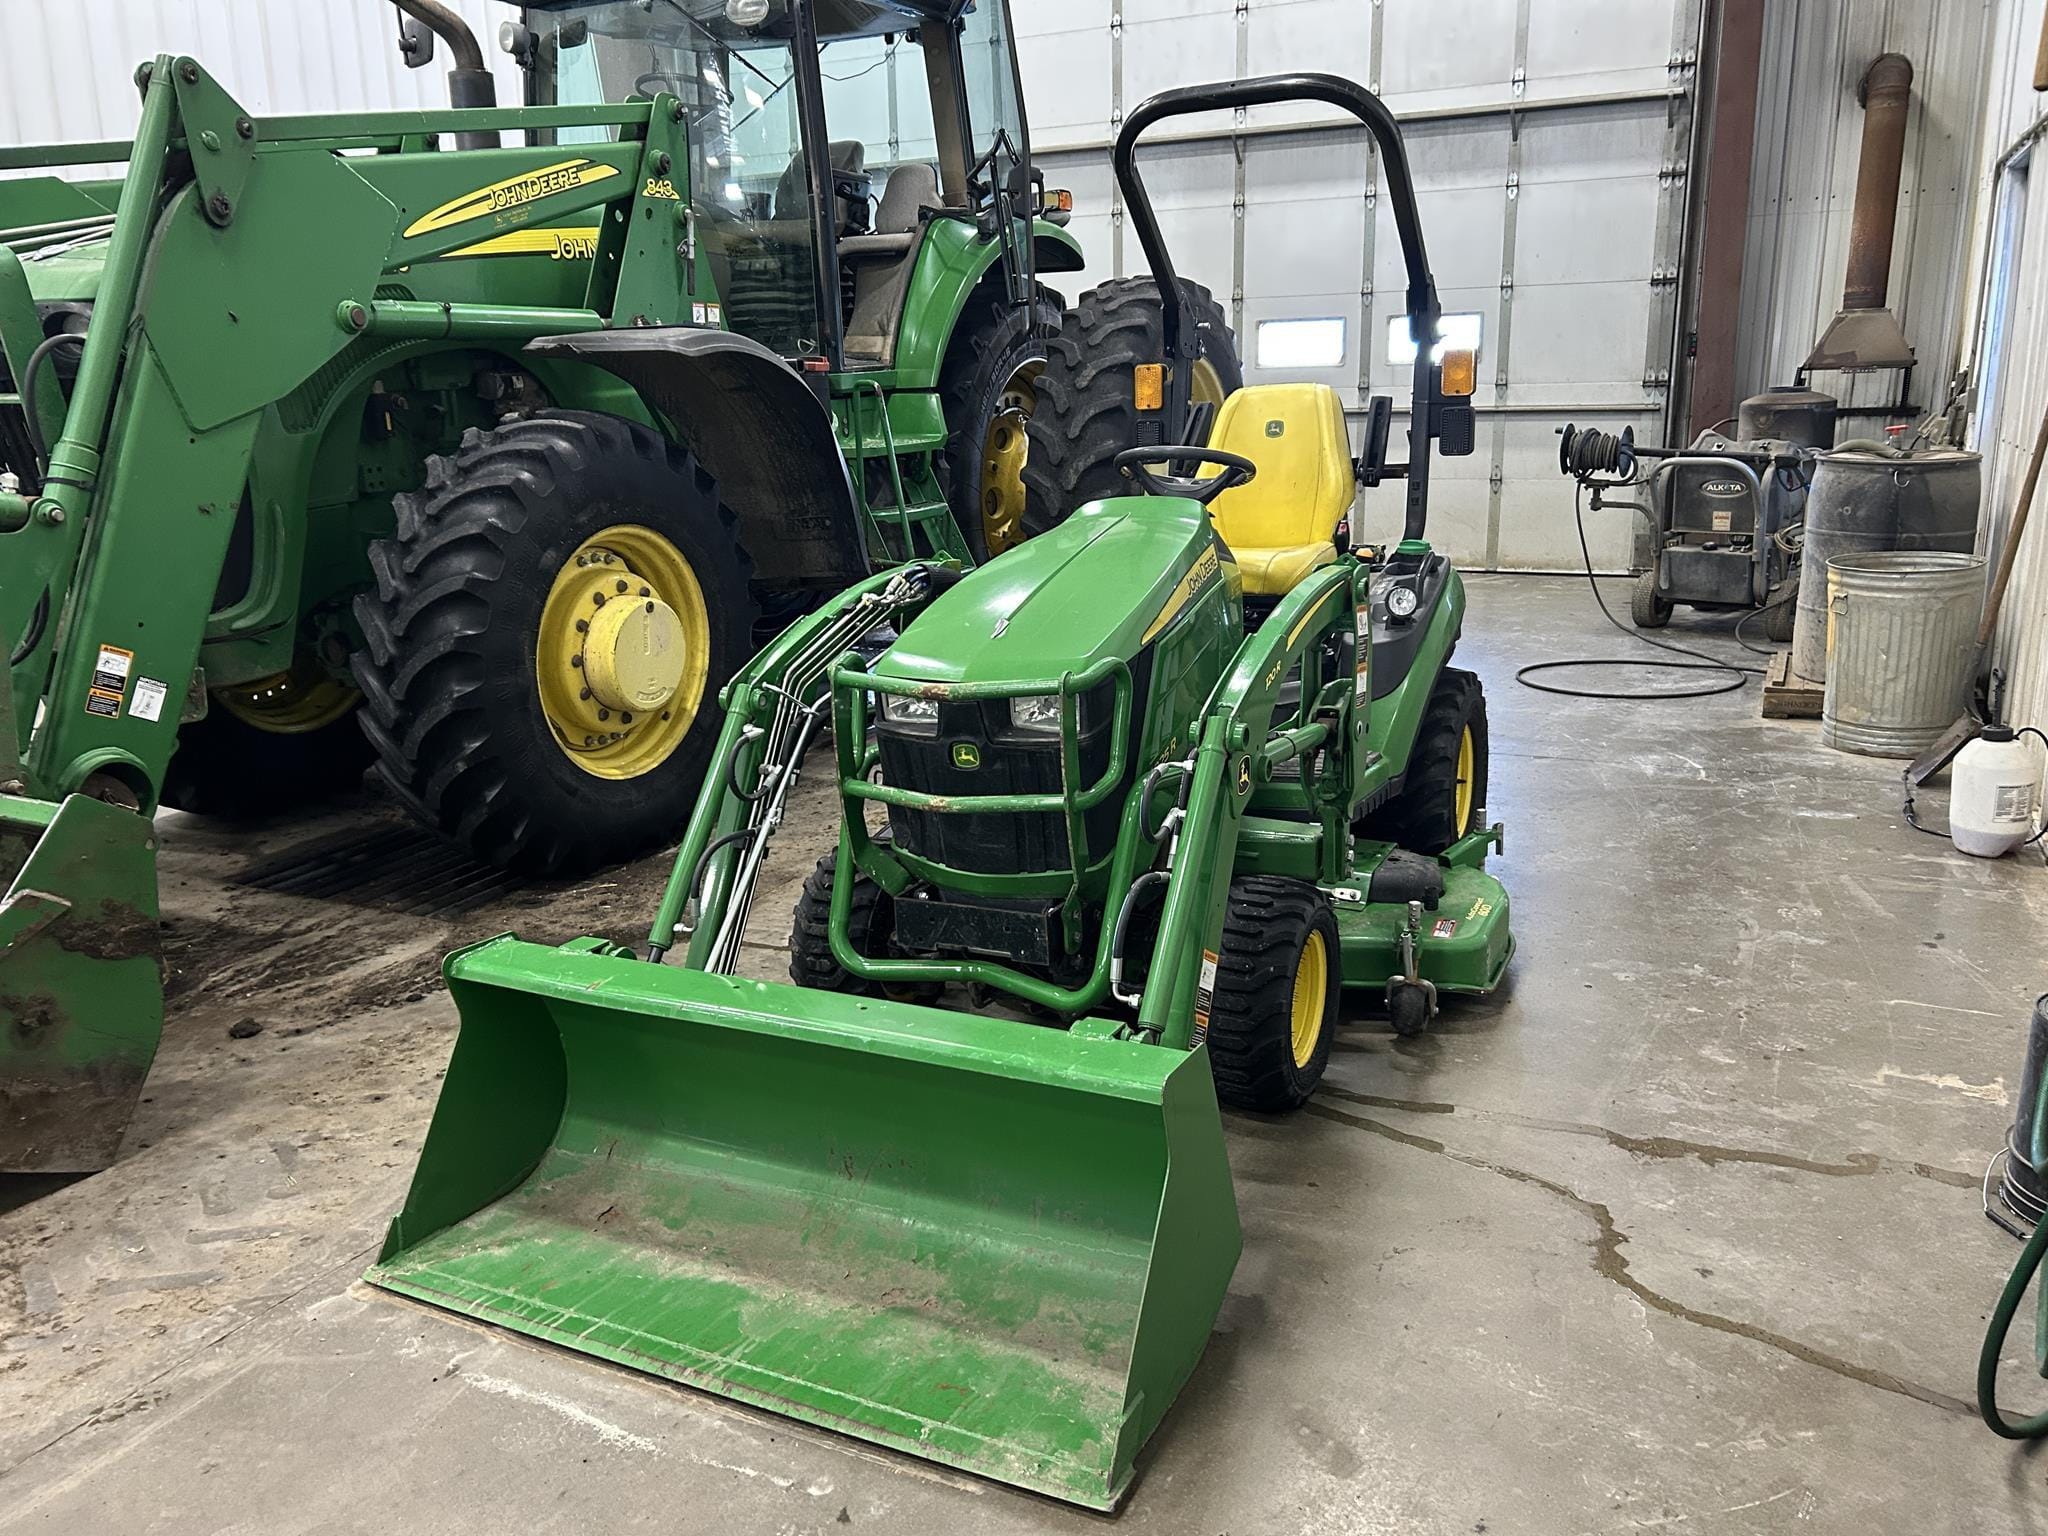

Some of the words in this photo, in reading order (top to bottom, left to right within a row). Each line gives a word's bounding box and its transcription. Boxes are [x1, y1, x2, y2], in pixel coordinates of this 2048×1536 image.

[488, 184, 528, 210] JOHN
[527, 168, 581, 195] DEERE
[646, 178, 672, 196] 843
[1187, 570, 1203, 597] JOHN
[1200, 554, 1218, 580] DEERE
